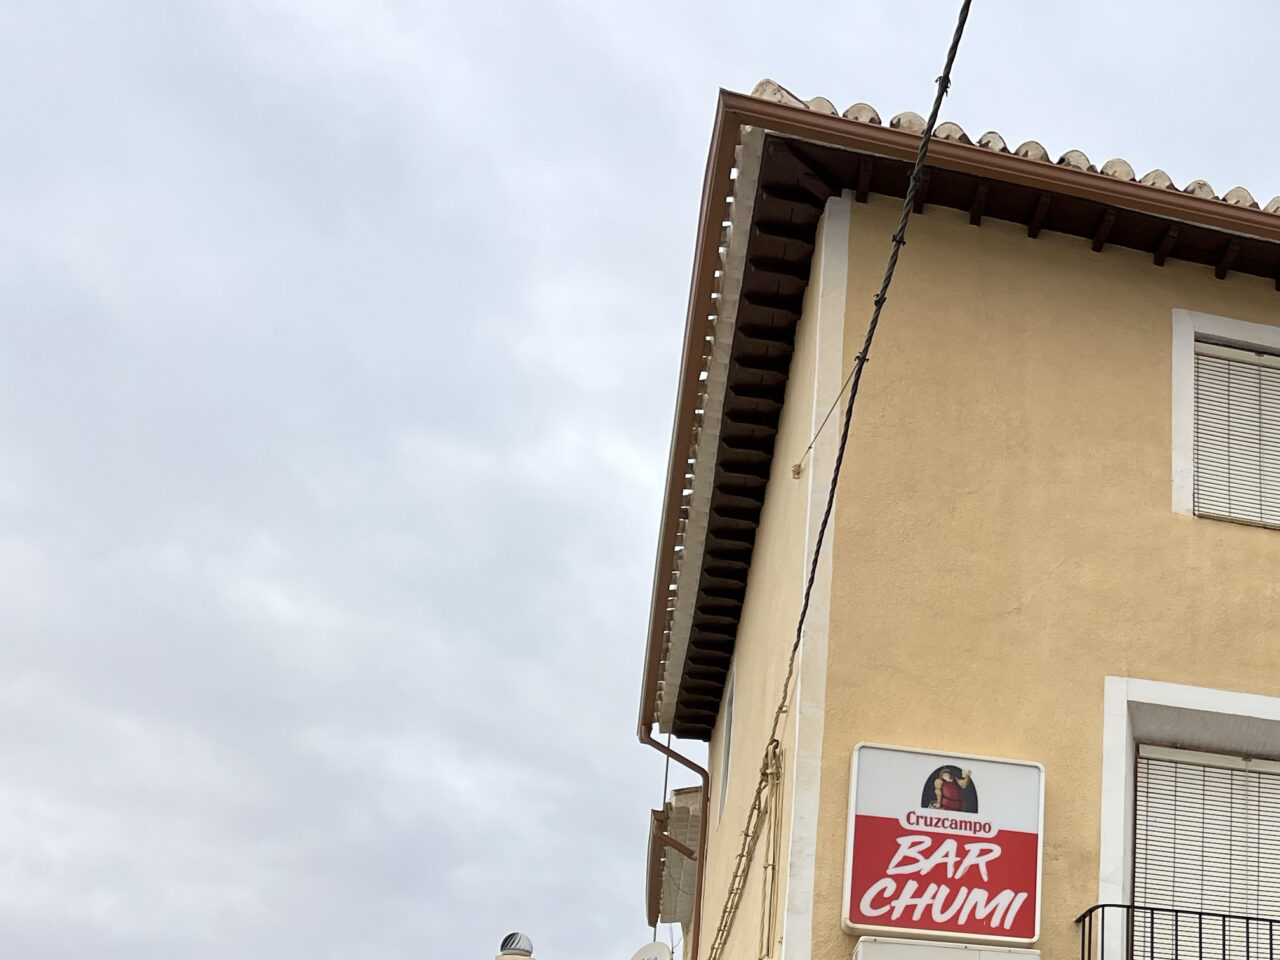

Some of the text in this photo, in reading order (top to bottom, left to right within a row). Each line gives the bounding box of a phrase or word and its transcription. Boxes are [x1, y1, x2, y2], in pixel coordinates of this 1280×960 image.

[906, 811, 992, 834] Cruzcampo
[886, 835, 1001, 881] BAR
[859, 877, 1028, 929] CHUMI
